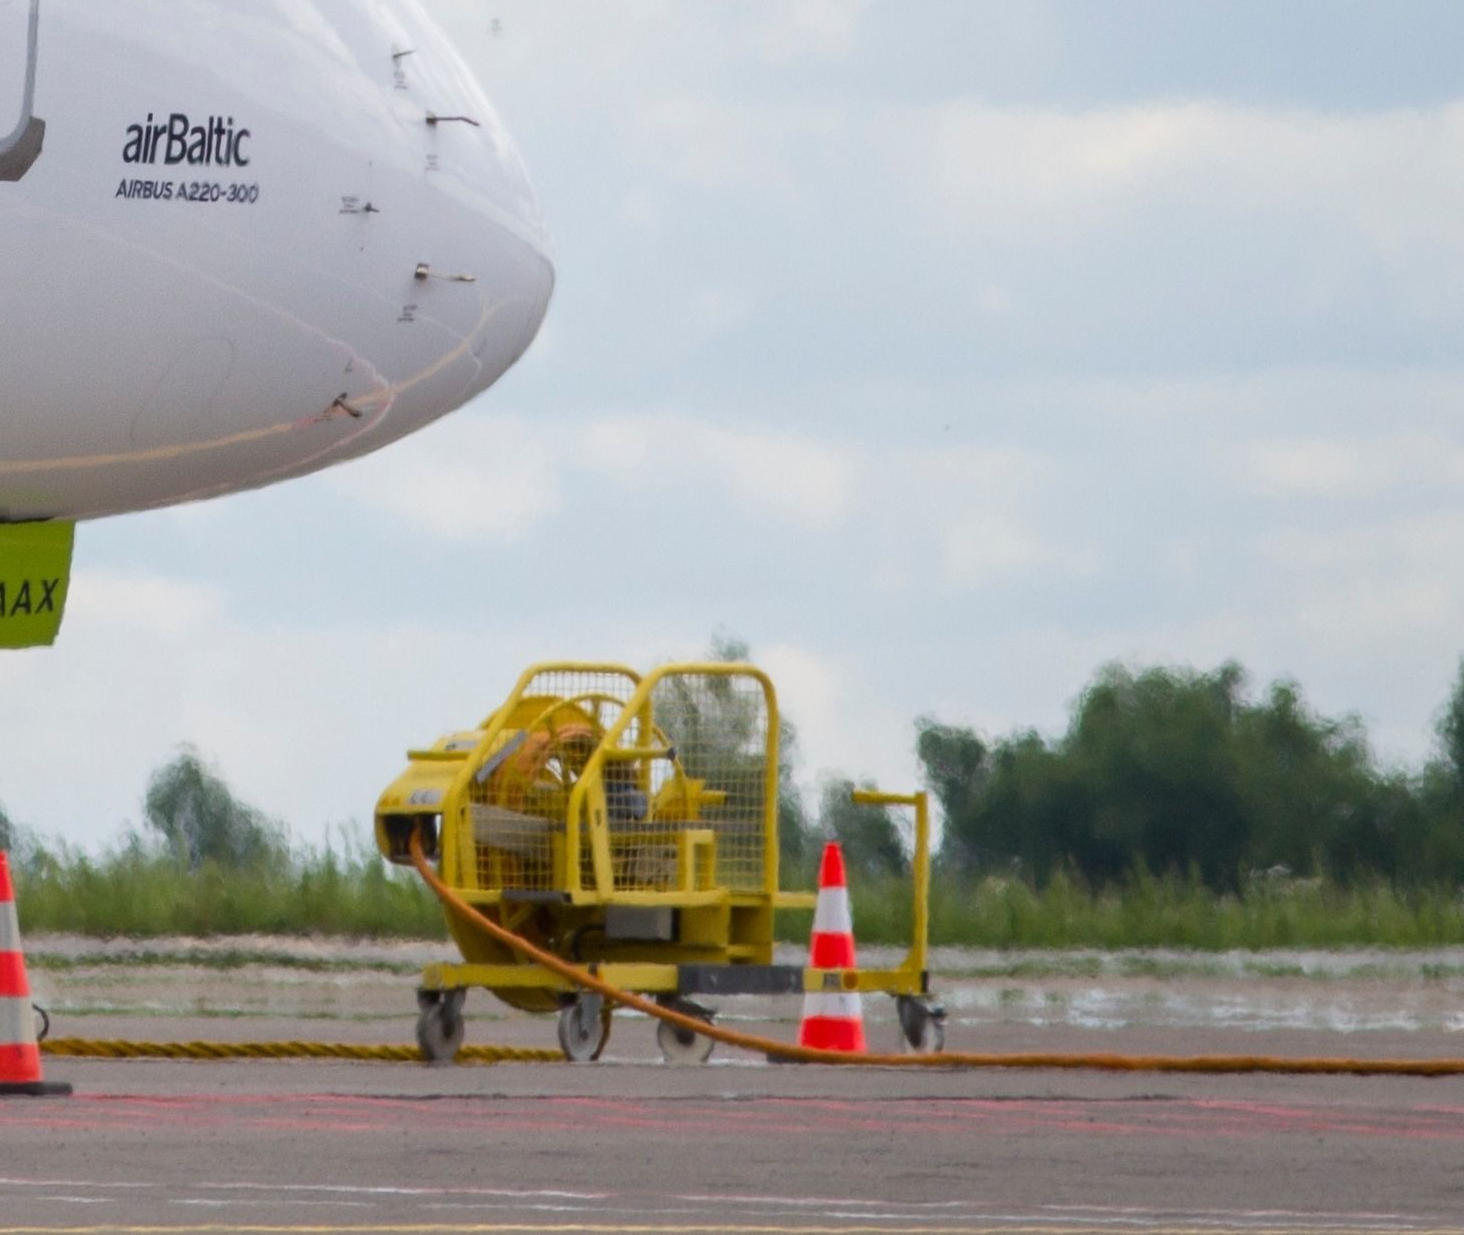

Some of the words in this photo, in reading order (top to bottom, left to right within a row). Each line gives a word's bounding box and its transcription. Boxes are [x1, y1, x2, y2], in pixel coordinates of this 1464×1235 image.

[123, 112, 251, 167] airBaltic
[115, 178, 173, 200] AIRBUS
[175, 181, 259, 204] A220-300
